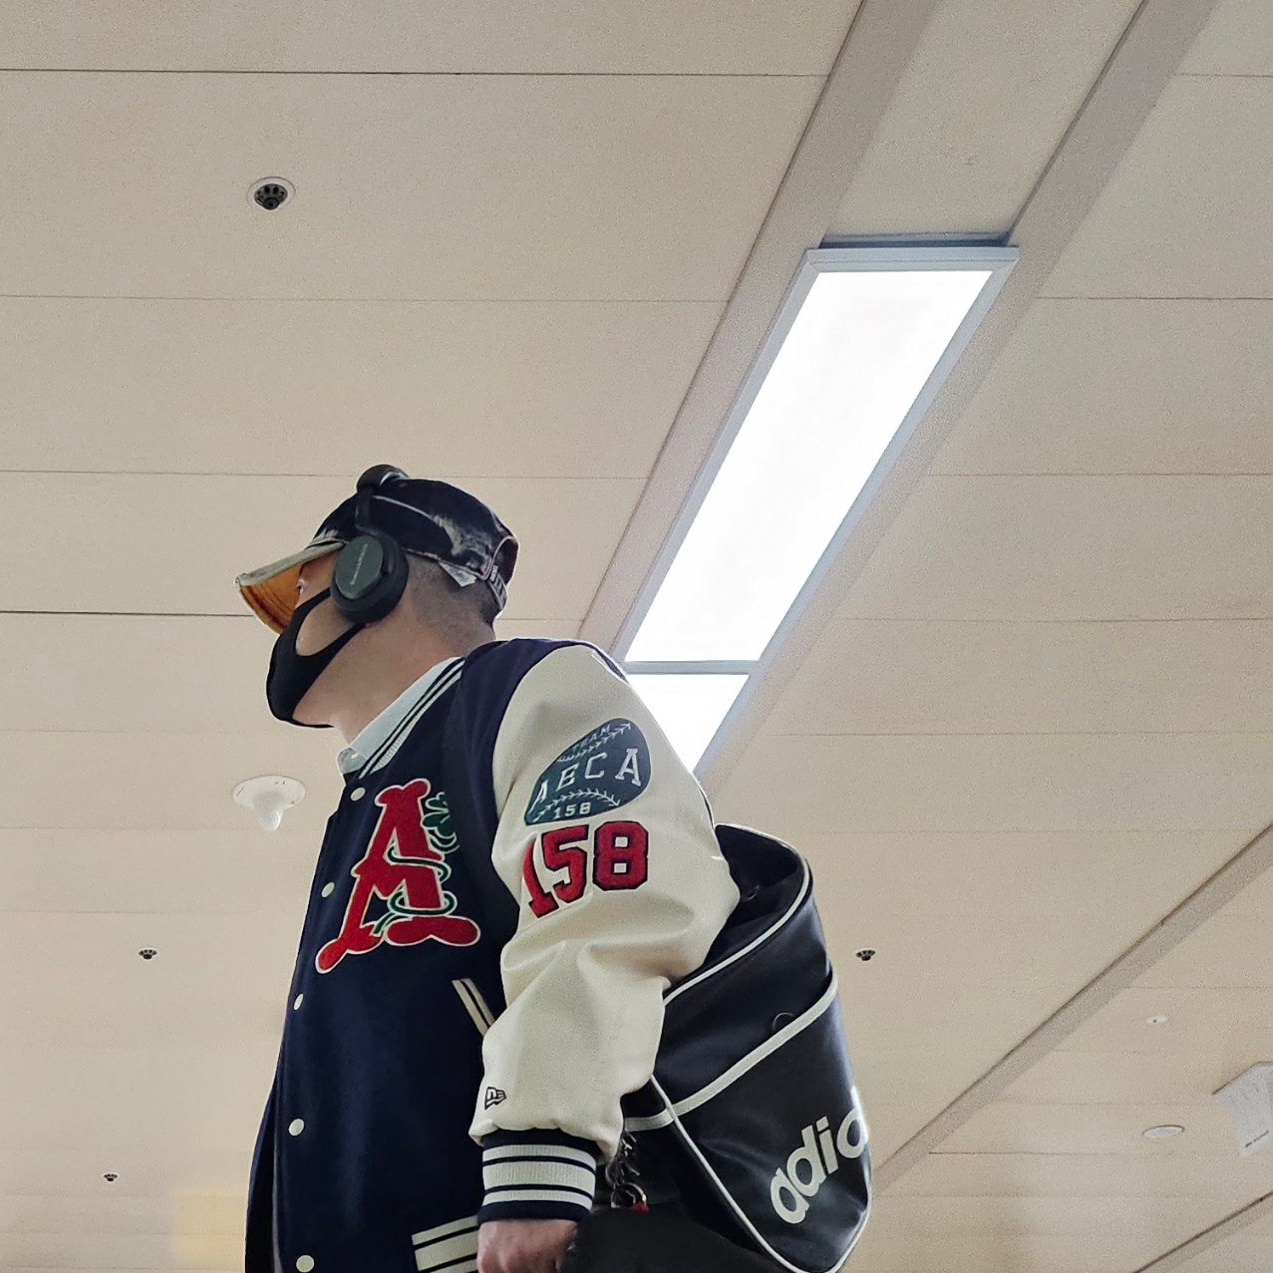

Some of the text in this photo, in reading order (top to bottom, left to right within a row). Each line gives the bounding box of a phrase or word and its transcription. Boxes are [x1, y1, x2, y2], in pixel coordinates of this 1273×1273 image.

[571, 724, 612, 752] TEAM
[553, 802, 591, 819] 158
[522, 820, 649, 918] 158
